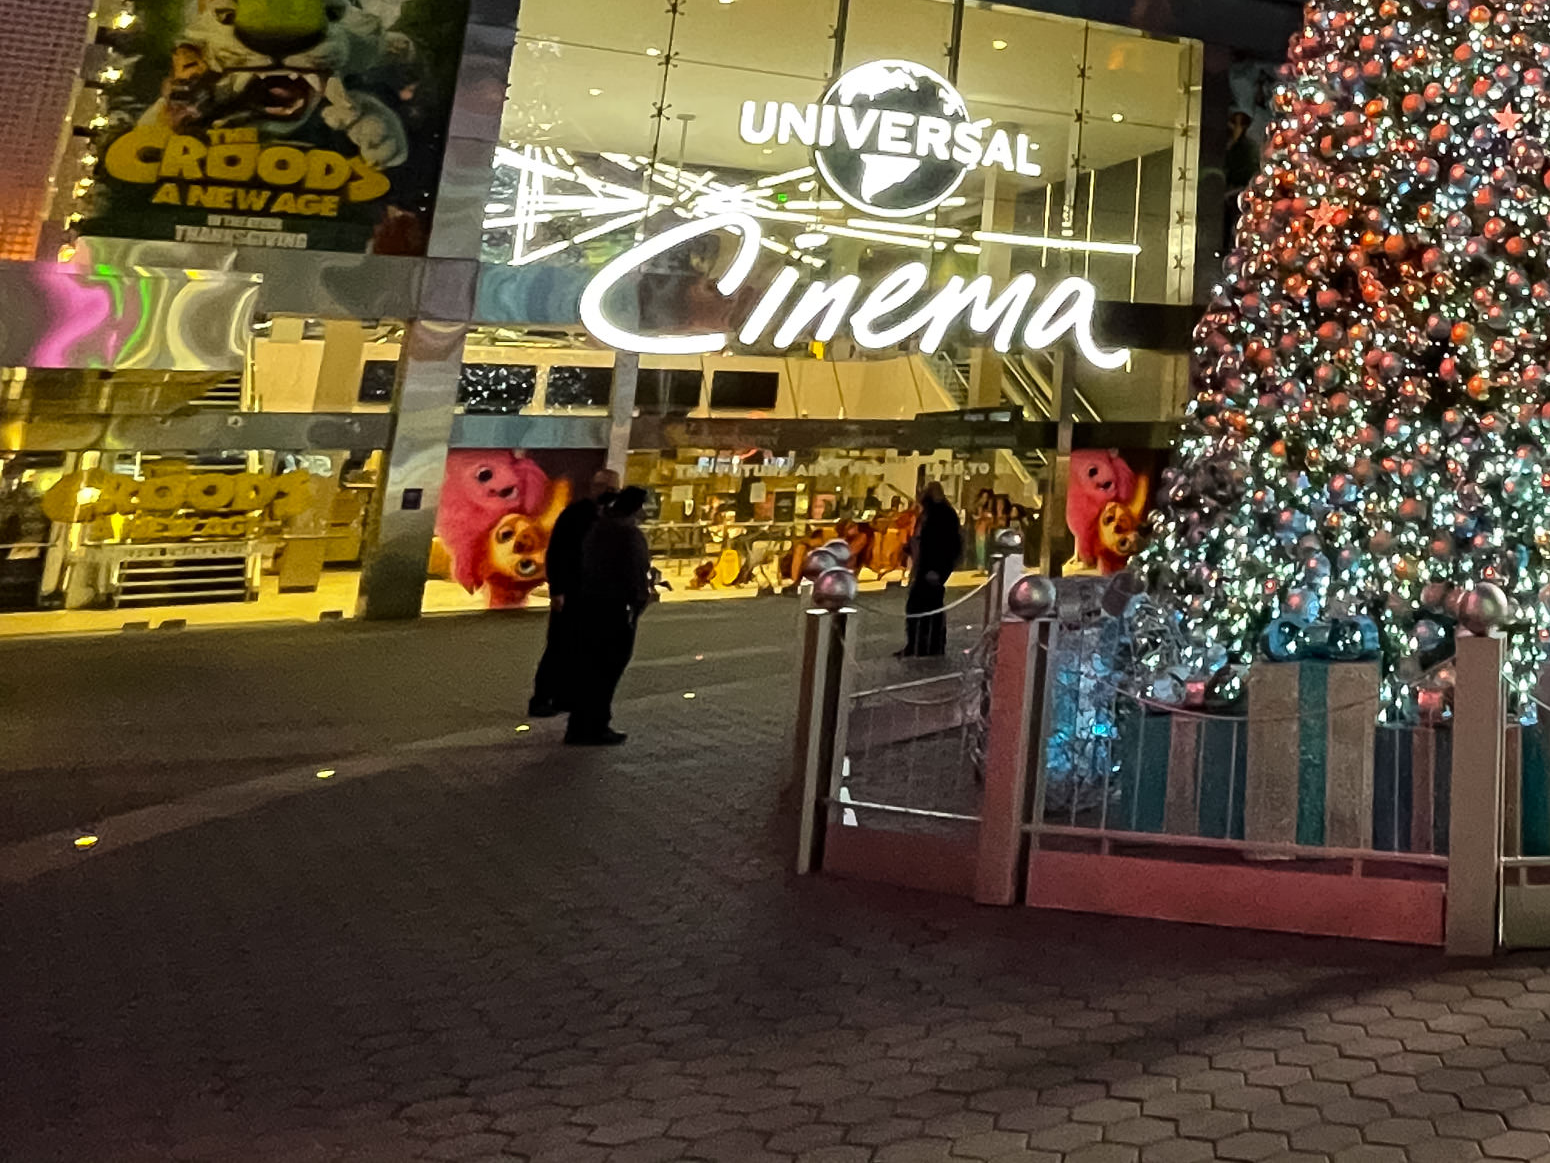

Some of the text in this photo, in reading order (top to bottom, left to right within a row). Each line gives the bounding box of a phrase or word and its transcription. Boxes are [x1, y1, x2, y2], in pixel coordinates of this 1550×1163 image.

[104, 124, 391, 202] CROODS
[739, 100, 1042, 178] UNIVERSAL
[152, 183, 340, 217] A NEW AGE
[579, 211, 1129, 371] Cinema
